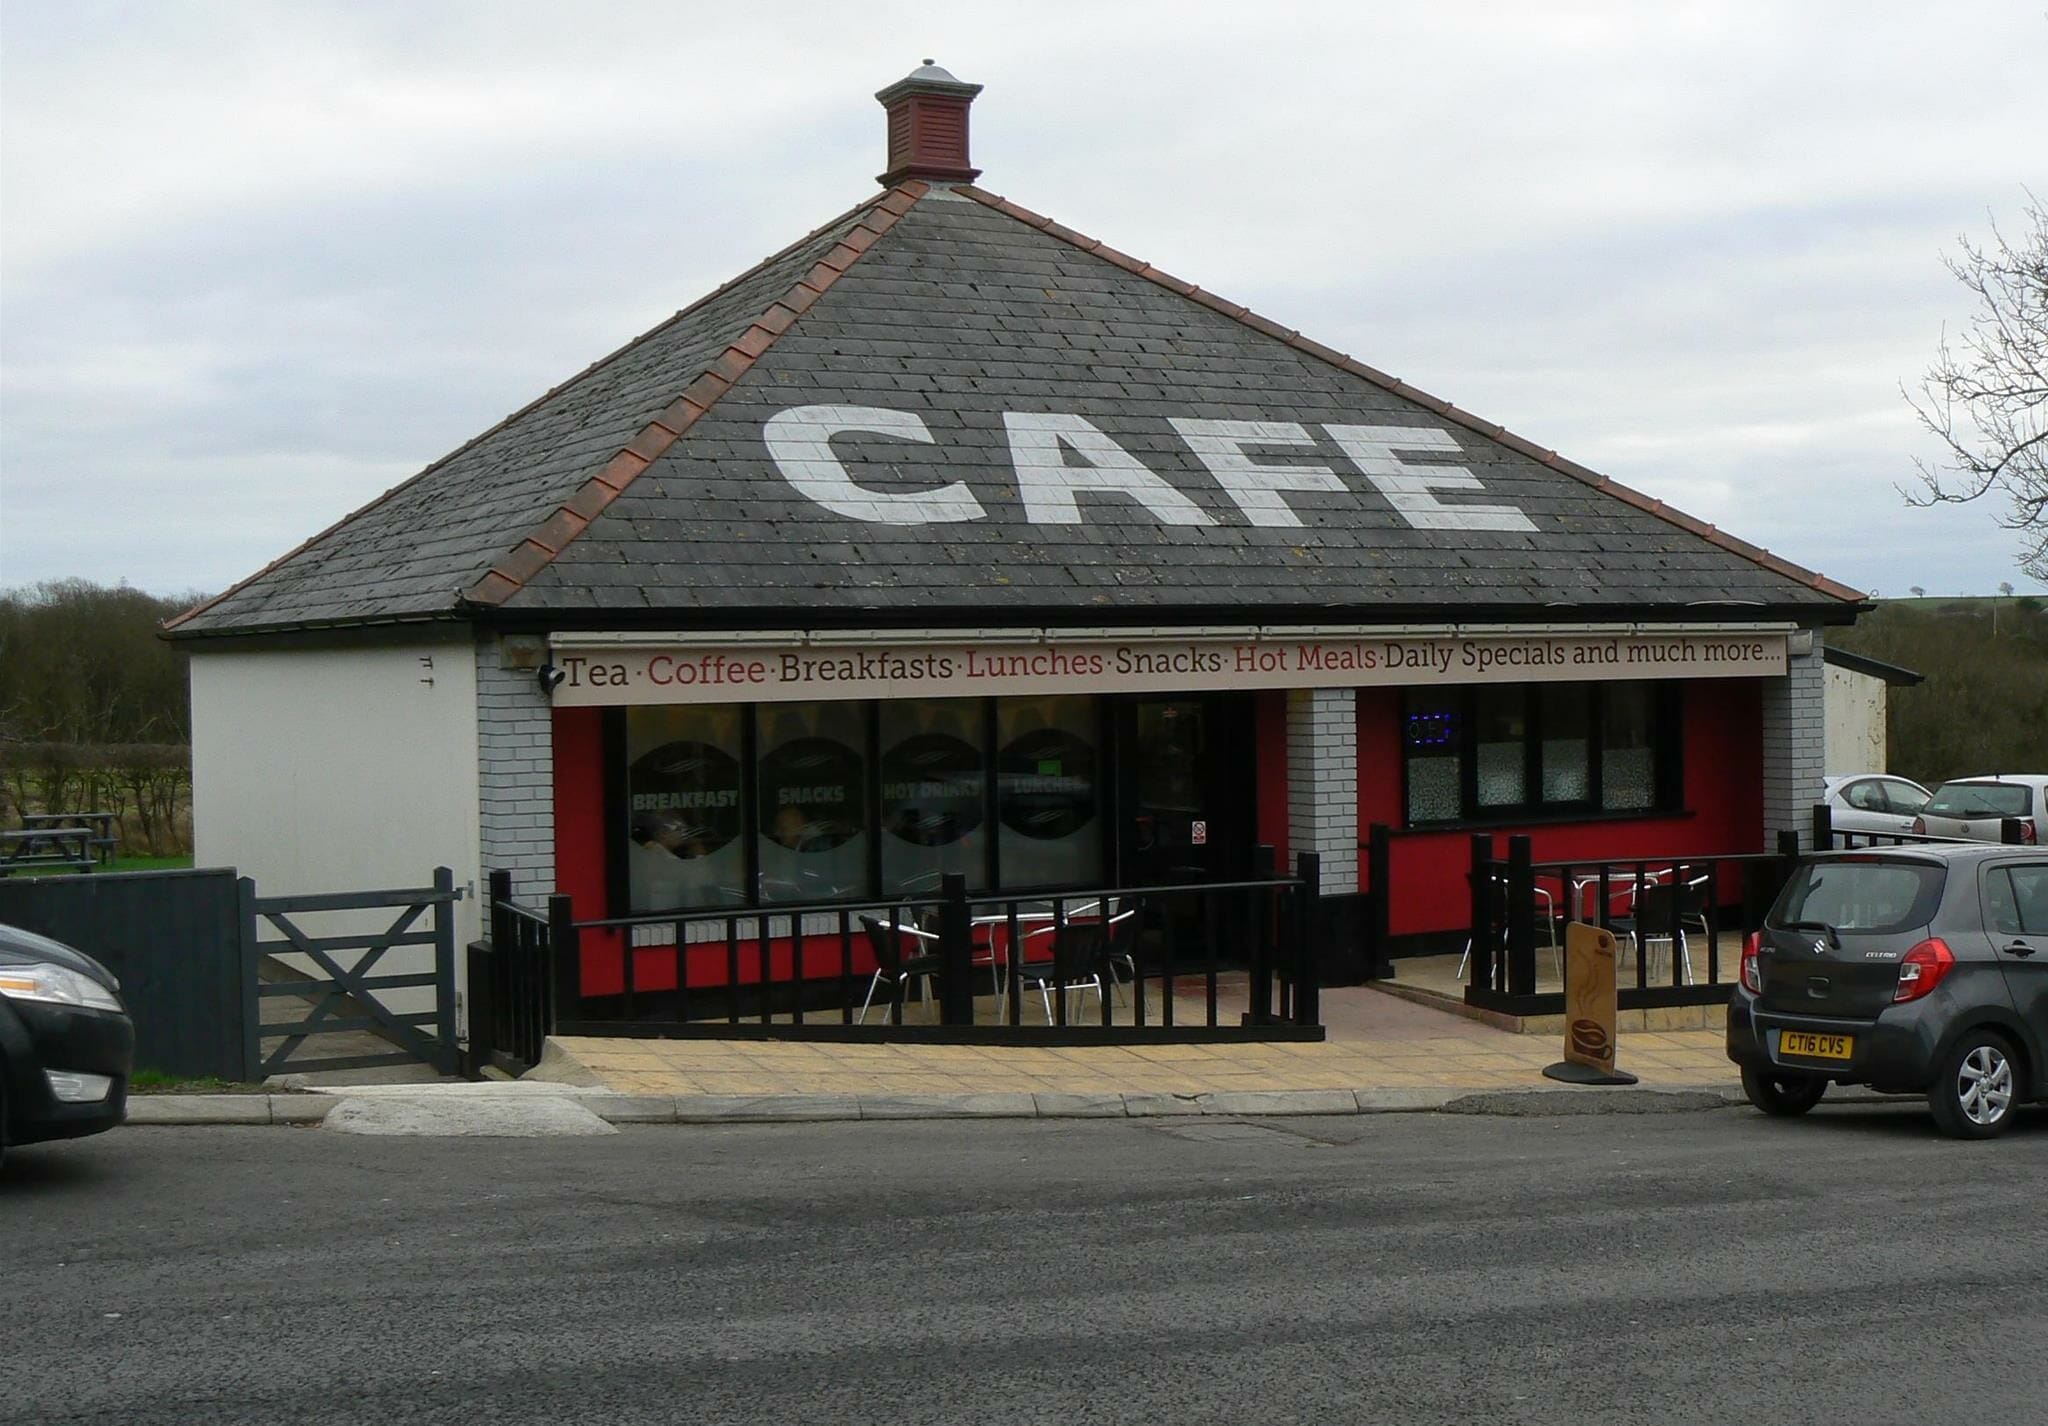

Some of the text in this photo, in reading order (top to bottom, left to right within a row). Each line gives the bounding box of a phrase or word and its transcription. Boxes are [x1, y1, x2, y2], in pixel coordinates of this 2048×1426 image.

[763, 404, 1540, 532] CAFE
[562, 658, 629, 686] Tea
[649, 656, 765, 685] Coffee
[779, 652, 953, 682] Breakfasts
[966, 648, 1102, 678] Lunches
[1116, 647, 1221, 675] Snacks
[1233, 646, 1287, 673] Hot
[1297, 644, 1376, 671] Meals
[1384, 642, 1453, 673] Daily
[1462, 641, 1565, 672] Specials
[1573, 640, 1619, 664] and
[1627, 639, 1696, 663] much
[633, 790, 738, 810] BREAKFAST
[777, 786, 845, 805] SNACKS
[1788, 1034, 1844, 1054] CT16 CVS
